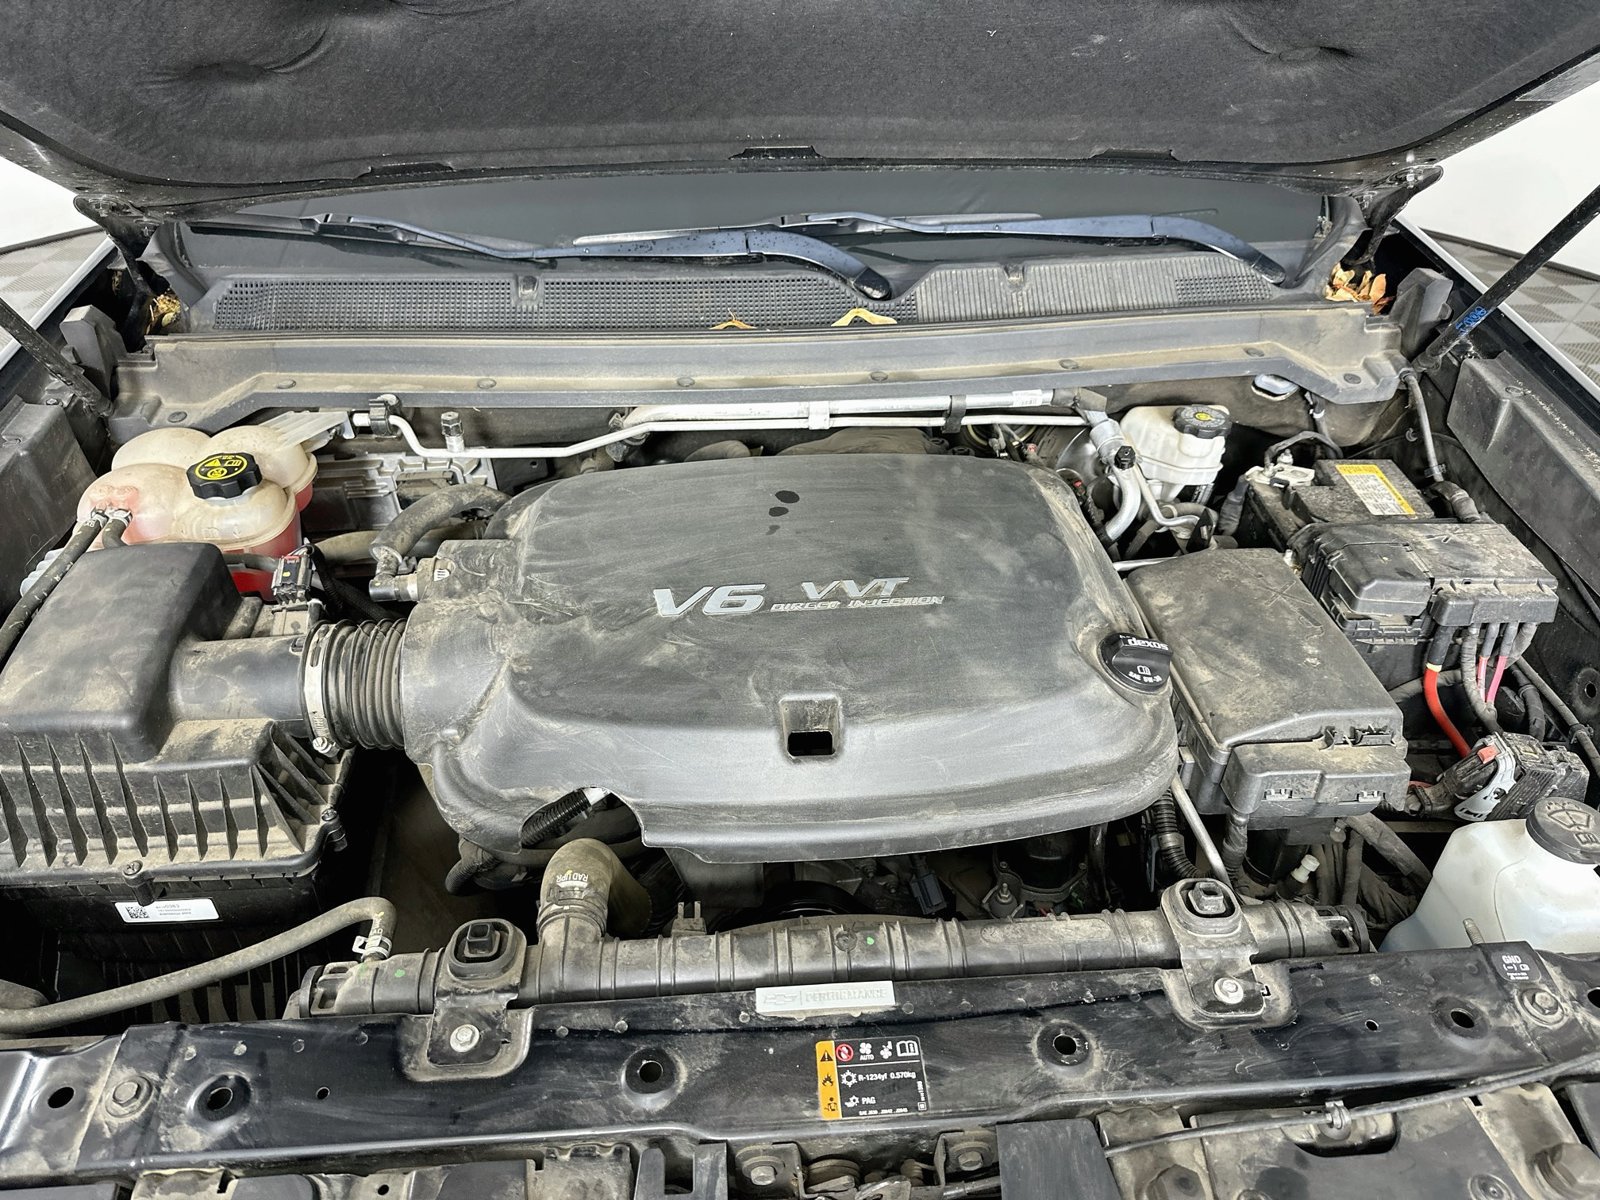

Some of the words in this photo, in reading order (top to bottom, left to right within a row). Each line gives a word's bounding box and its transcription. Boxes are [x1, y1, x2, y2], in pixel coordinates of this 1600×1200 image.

[801, 577, 909, 599] VVT
[653, 584, 766, 617] V6
[770, 600, 840, 612] DIRECT
[848, 595, 945, 608] INJECTION
[1127, 638, 1168, 650] dexos
[572, 873, 589, 882] RAD
[1502, 955, 1522, 964] GND
[858, 1072, 888, 1082] R-1234yf
[889, 1071, 917, 1079] 0.570kg
